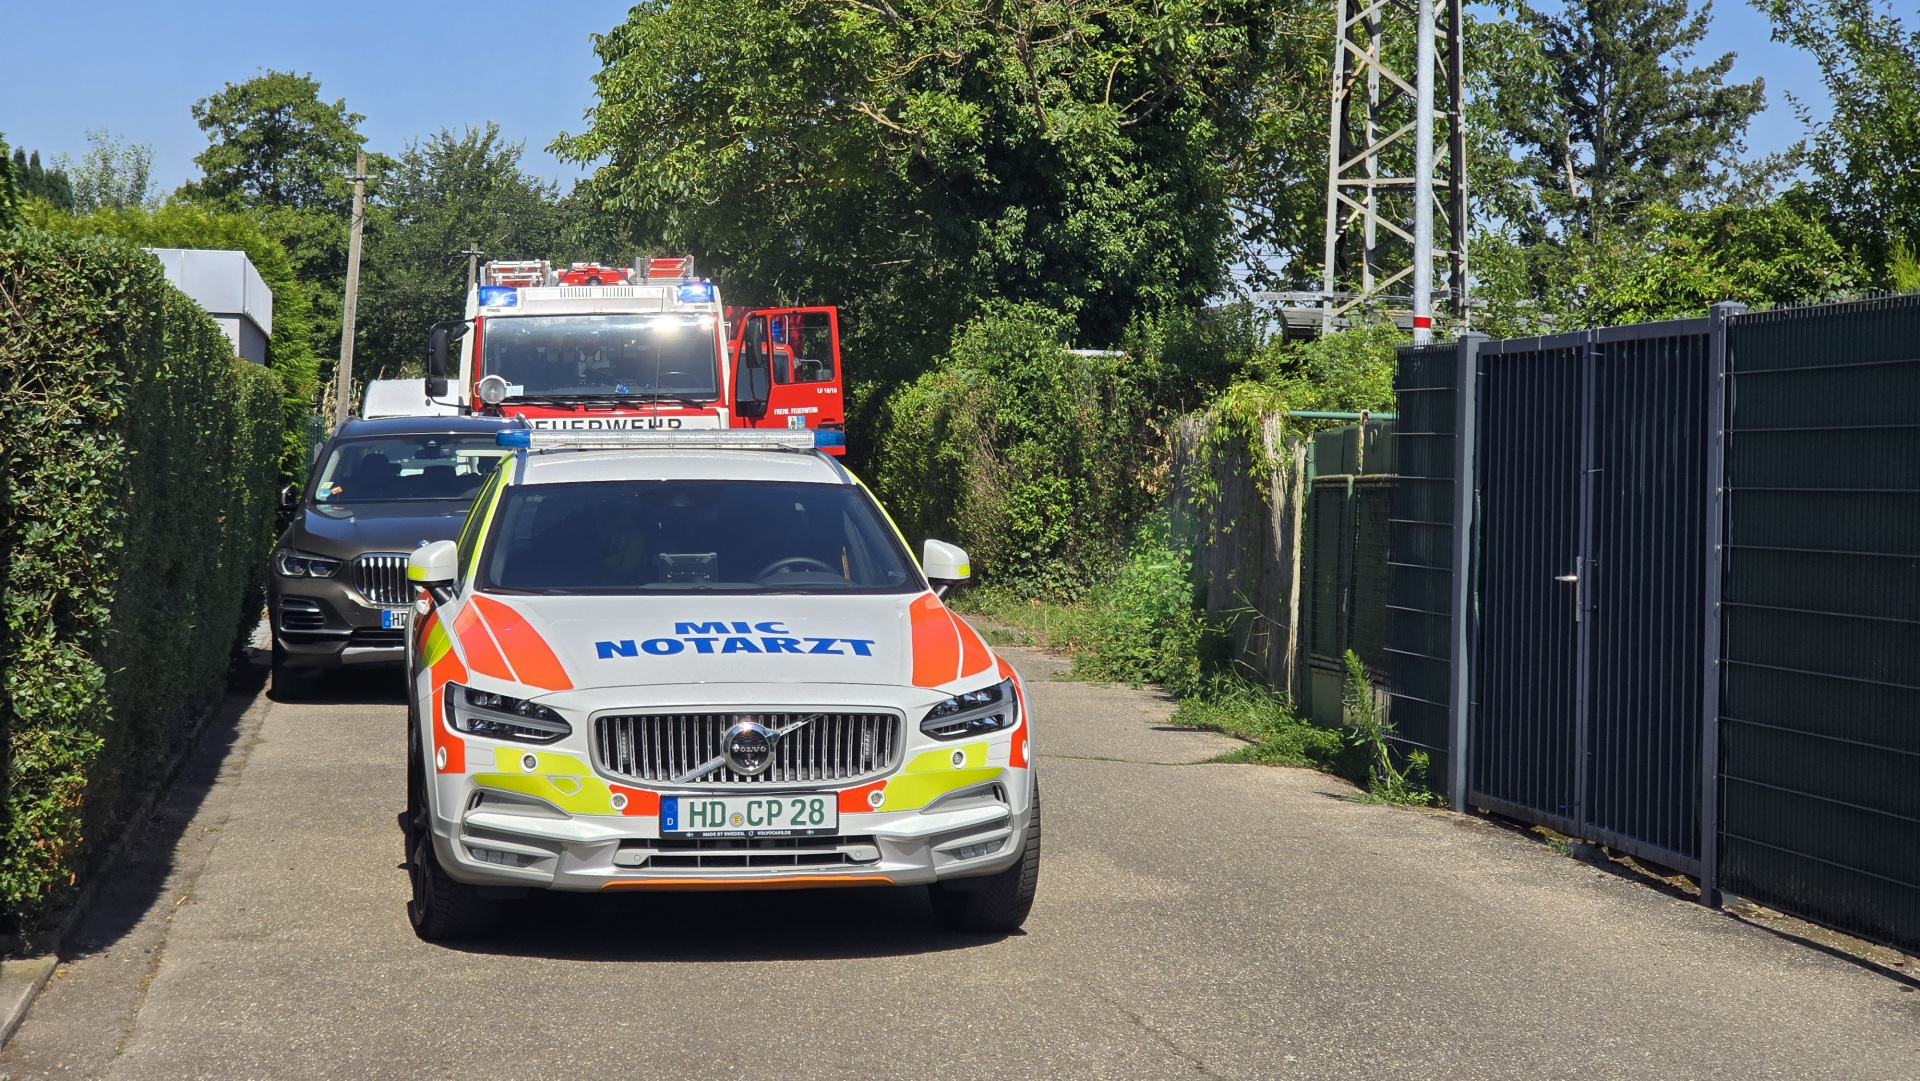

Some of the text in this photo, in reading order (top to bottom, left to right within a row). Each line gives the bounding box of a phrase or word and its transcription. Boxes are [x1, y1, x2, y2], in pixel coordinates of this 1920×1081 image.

[674, 621, 790, 635] MIC
[595, 636, 876, 660] NOTARZT
[666, 817, 674, 826] D
[689, 798, 825, 828] HD CP 28
